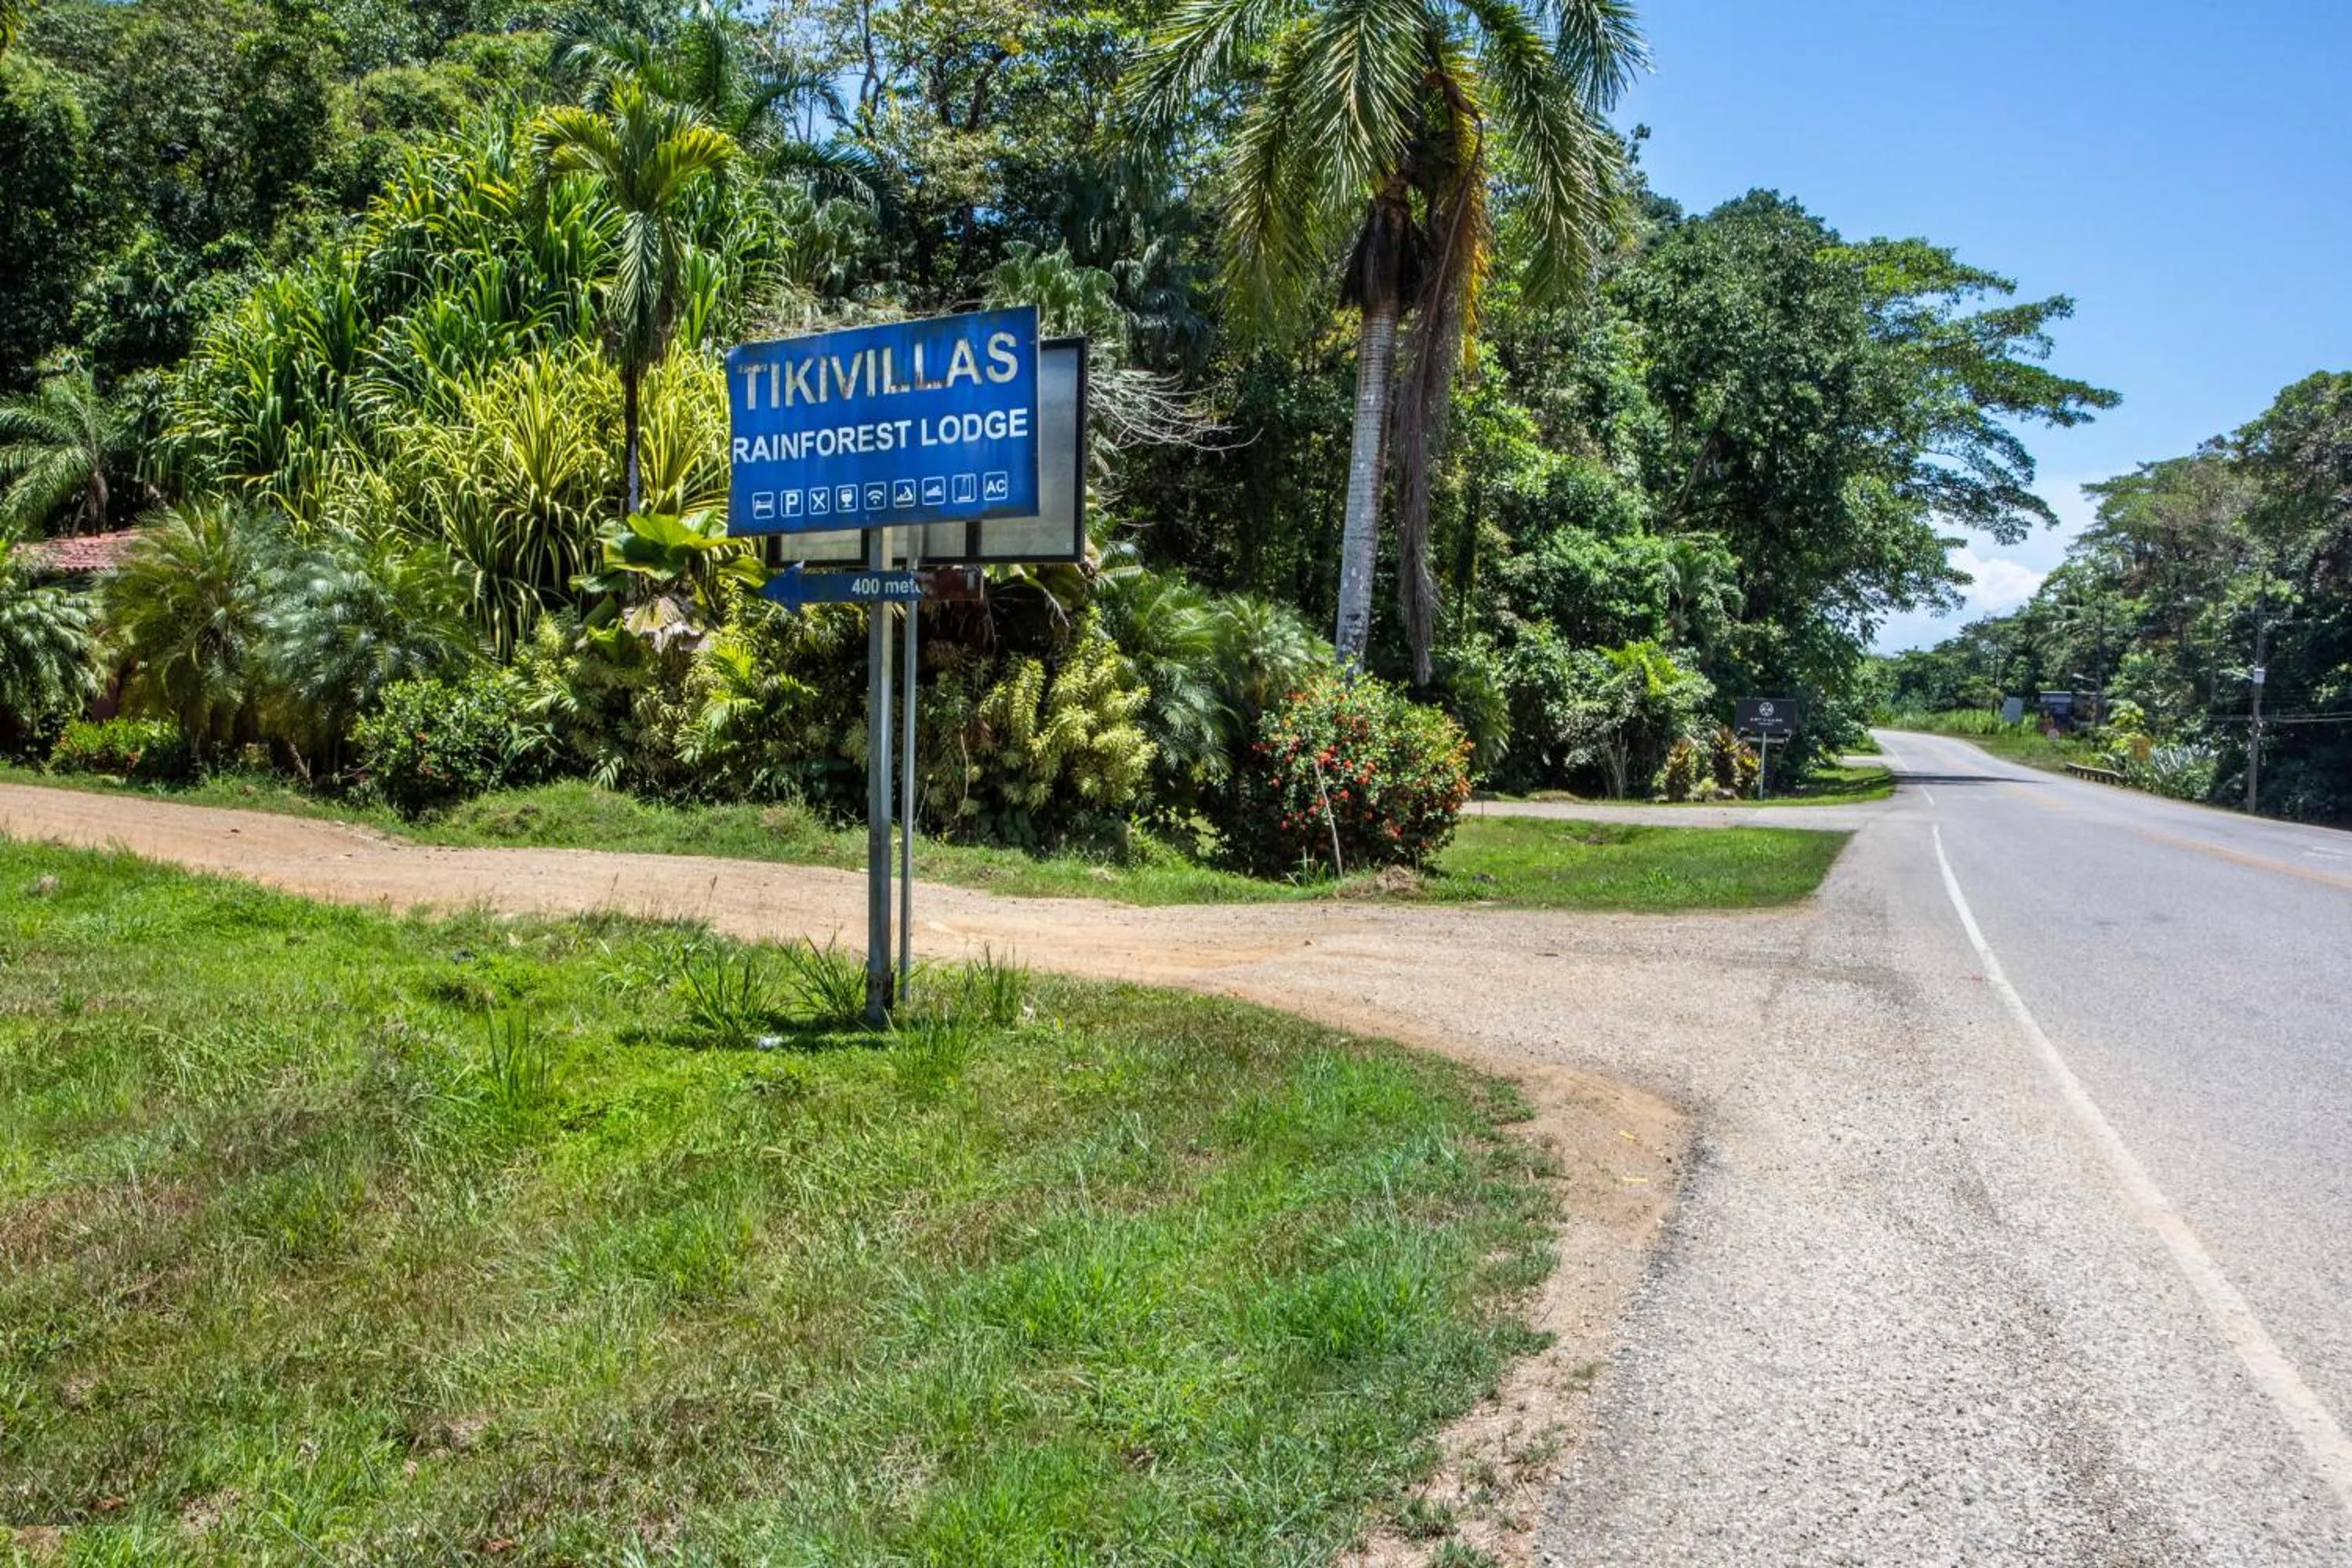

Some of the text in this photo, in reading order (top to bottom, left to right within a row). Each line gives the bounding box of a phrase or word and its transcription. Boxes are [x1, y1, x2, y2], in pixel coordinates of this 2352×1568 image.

[737, 331, 1019, 412] TIKIVILLAS
[732, 407, 1029, 464] RAINFOREST LODGE
[985, 479, 1007, 494] AC
[851, 577, 880, 595] 400
